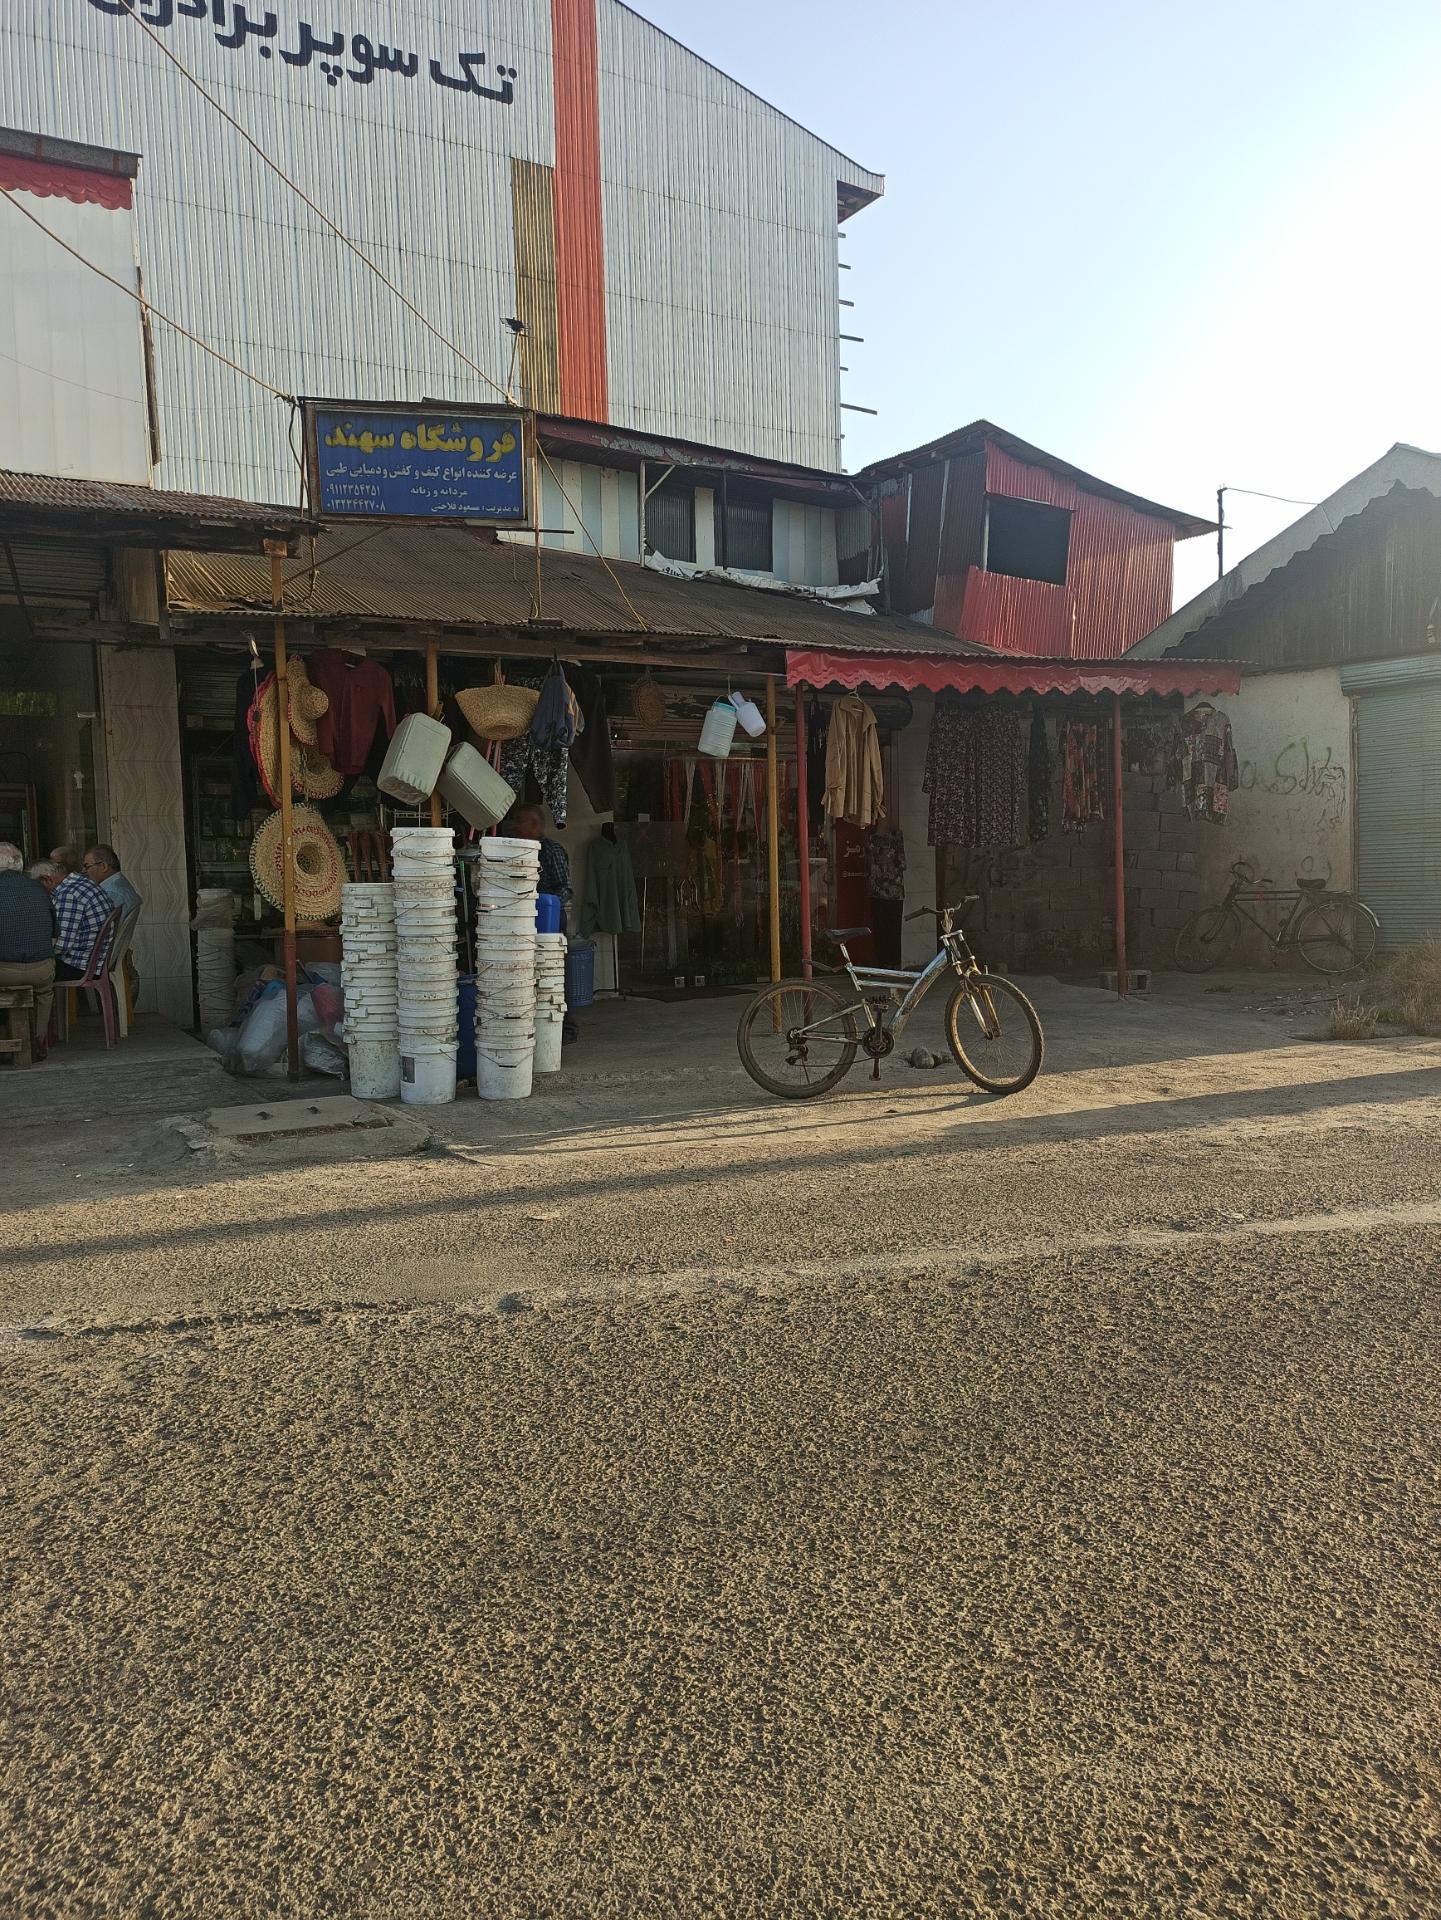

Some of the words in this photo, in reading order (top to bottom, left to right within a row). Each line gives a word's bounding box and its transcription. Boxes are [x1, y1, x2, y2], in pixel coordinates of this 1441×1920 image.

[279, 22, 418, 87] سوپر
[429, 52, 518, 105] تک
[325, 423, 395, 453] سهند
[400, 421, 517, 462] فروشگاه
[326, 462, 348, 477] طبی
[389, 465, 411, 478] کفش
[414, 469, 419, 479] و
[421, 465, 440, 478] کیف
[442, 467, 465, 481] انواع
[467, 468, 491, 480] کننده
[493, 470, 518, 483] عرضه
[410, 486, 431, 497] زنانه
[440, 487, 469, 498] مردانه
